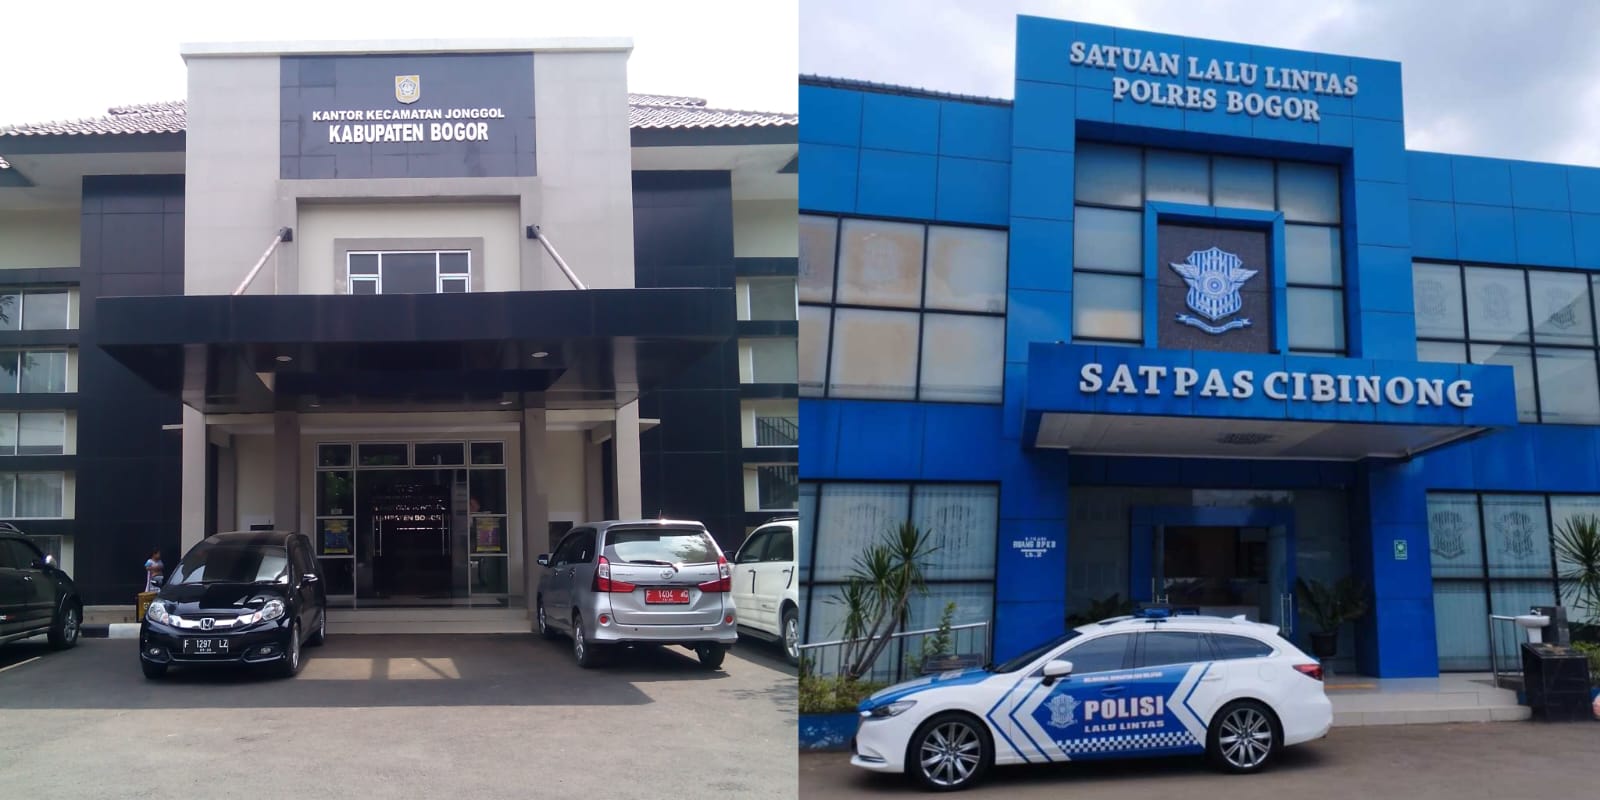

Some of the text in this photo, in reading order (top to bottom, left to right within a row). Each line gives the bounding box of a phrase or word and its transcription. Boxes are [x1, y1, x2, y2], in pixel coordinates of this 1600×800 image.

[1069, 41, 1359, 97] SATUAN LALU LINTAS
[1113, 77, 1321, 122] POLRES BOGOR
[312, 108, 505, 121] KANTOR KECAMATAN JONGGOL
[329, 122, 489, 143] KABUPATEN BOGOR
[1262, 371, 1474, 408] CIBINONG
[658, 590, 673, 598] 1404
[185, 640, 190, 648] F
[197, 640, 211, 648] 1297
[1084, 696, 1164, 720] POLISI
[1085, 720, 1164, 732] LALU LINTAS
